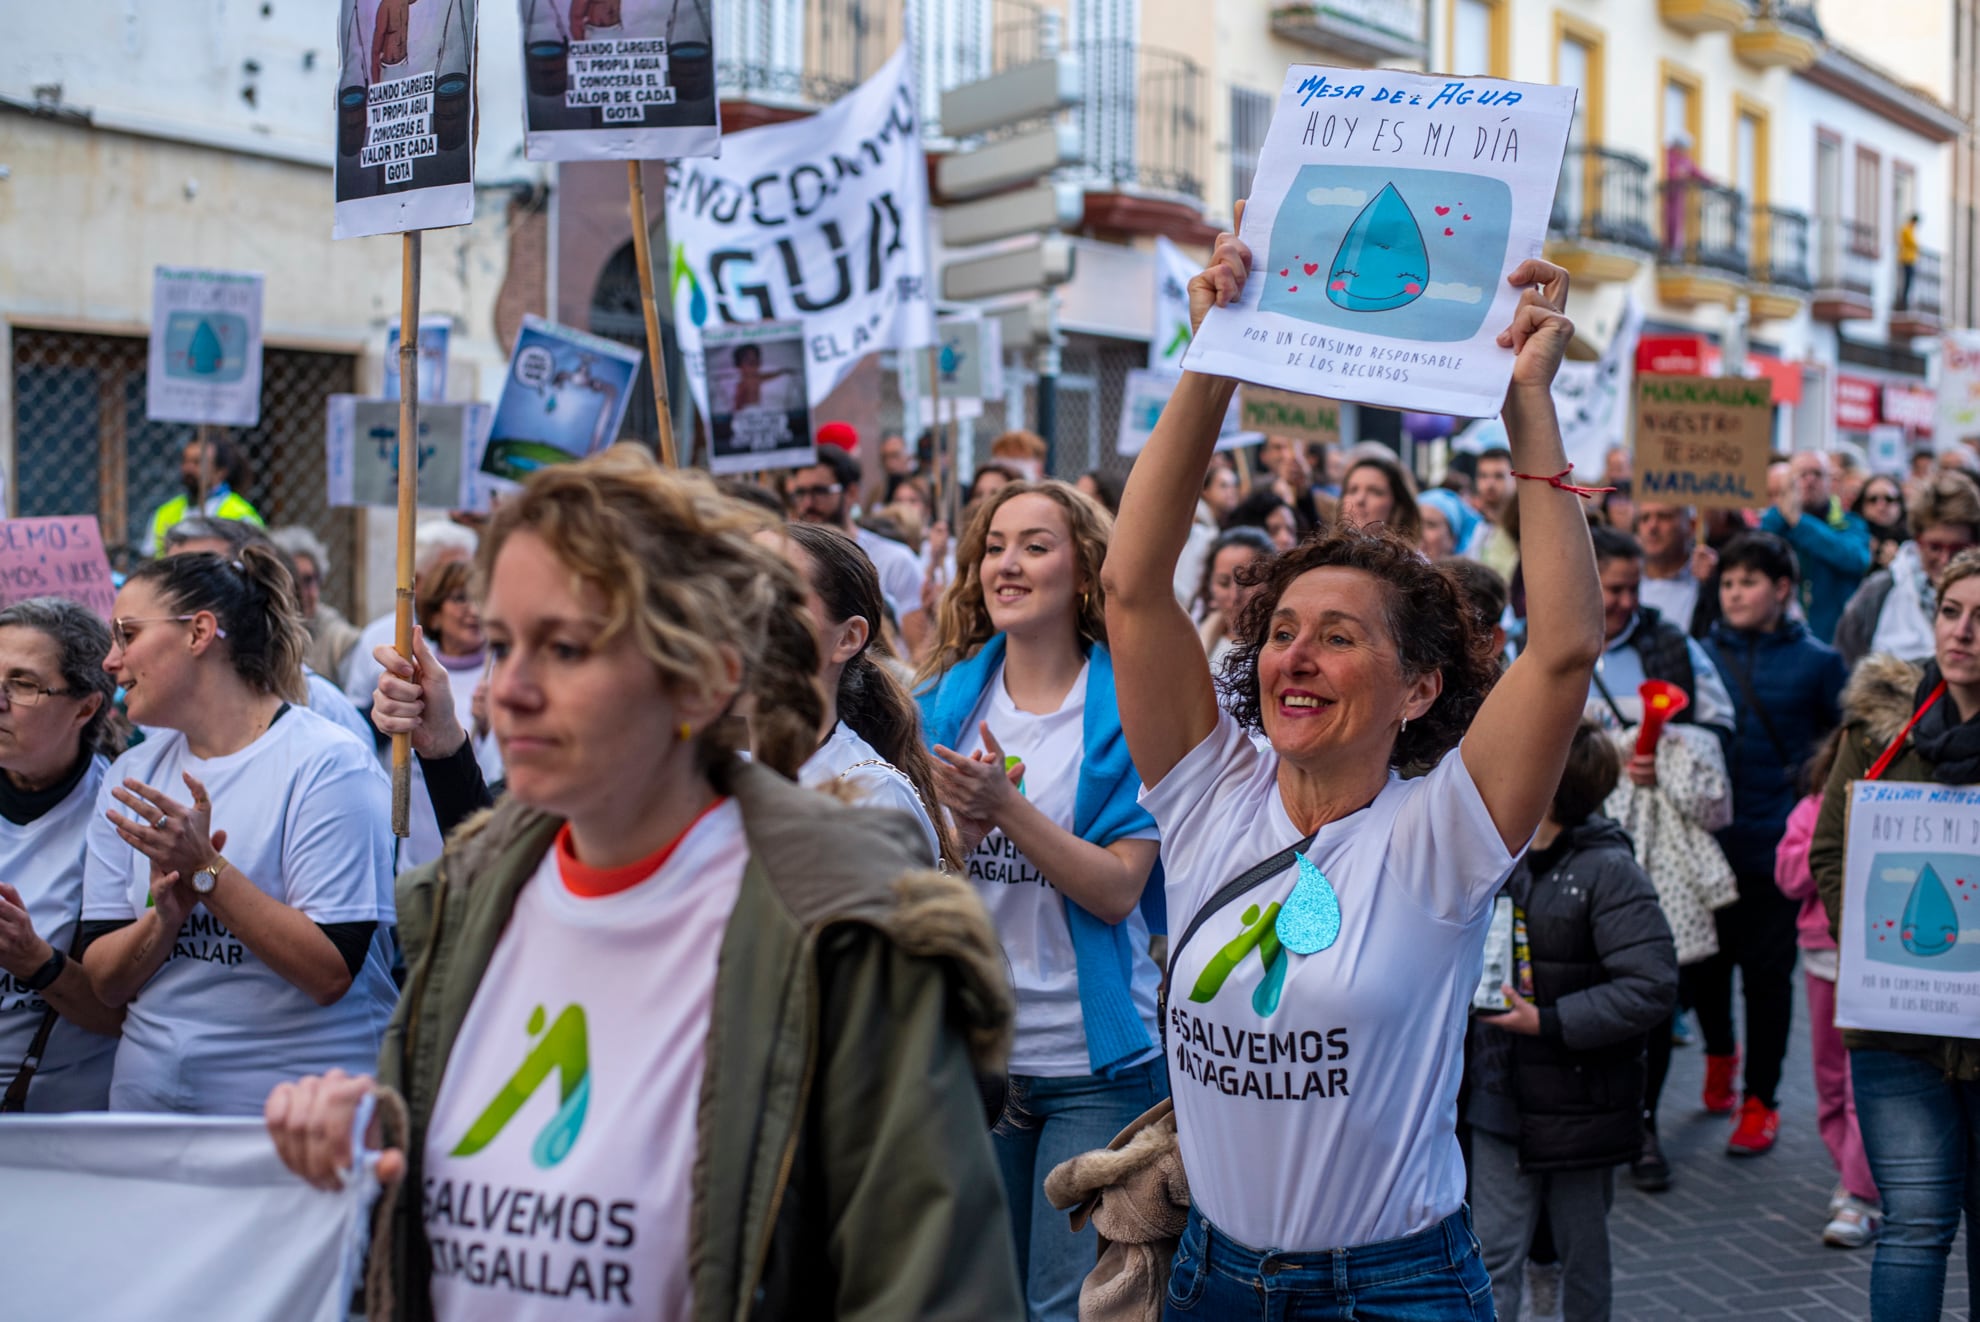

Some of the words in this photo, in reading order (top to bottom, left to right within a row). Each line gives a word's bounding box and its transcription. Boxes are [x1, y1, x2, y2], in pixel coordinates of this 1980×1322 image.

[569, 42, 613, 55] CUANDO
[616, 40, 664, 53] CARGUES
[575, 60, 588, 72] TU
[590, 59, 630, 72] PROPIA
[633, 57, 660, 70] AGUA
[368, 81, 400, 103] CUANDO
[401, 74, 434, 97] CARGUES
[579, 71, 643, 88] CONOCERÁS
[646, 74, 659, 86] EL
[1296, 74, 1365, 107] MESA
[1427, 82, 1523, 110] AGUA
[372, 108, 381, 125] TU
[382, 101, 409, 122] PROPIA
[410, 96, 428, 116] AGUA
[567, 91, 611, 105] VALOR
[614, 90, 633, 103] DE
[635, 89, 672, 102] CADA
[605, 106, 640, 119] GOTA
[372, 118, 416, 143] CONOCERÁS
[416, 118, 425, 135] EL
[1302, 111, 1359, 149] HOY
[1372, 118, 1405, 153] ES
[1423, 121, 1456, 157] MI
[1473, 116, 1519, 163] DÍA
[361, 144, 392, 166] VALOR
[394, 142, 407, 160] DE
[407, 136, 435, 157] CADA
[387, 161, 411, 181] GOTA
[1243, 327, 1269, 344] POR
[1276, 331, 1293, 346] UN
[1300, 332, 1363, 358] CONSUMO
[1369, 345, 1464, 371] RESPONSABLE
[1286, 352, 1302, 367] DE
[1309, 354, 1334, 373] LOS
[1341, 361, 1409, 383] RECURSOS
[1643, 469, 1755, 499] NATURAL
[1871, 813, 1905, 842] HOY
[1913, 815, 1933, 843] ES
[1942, 816, 1961, 844] MI
